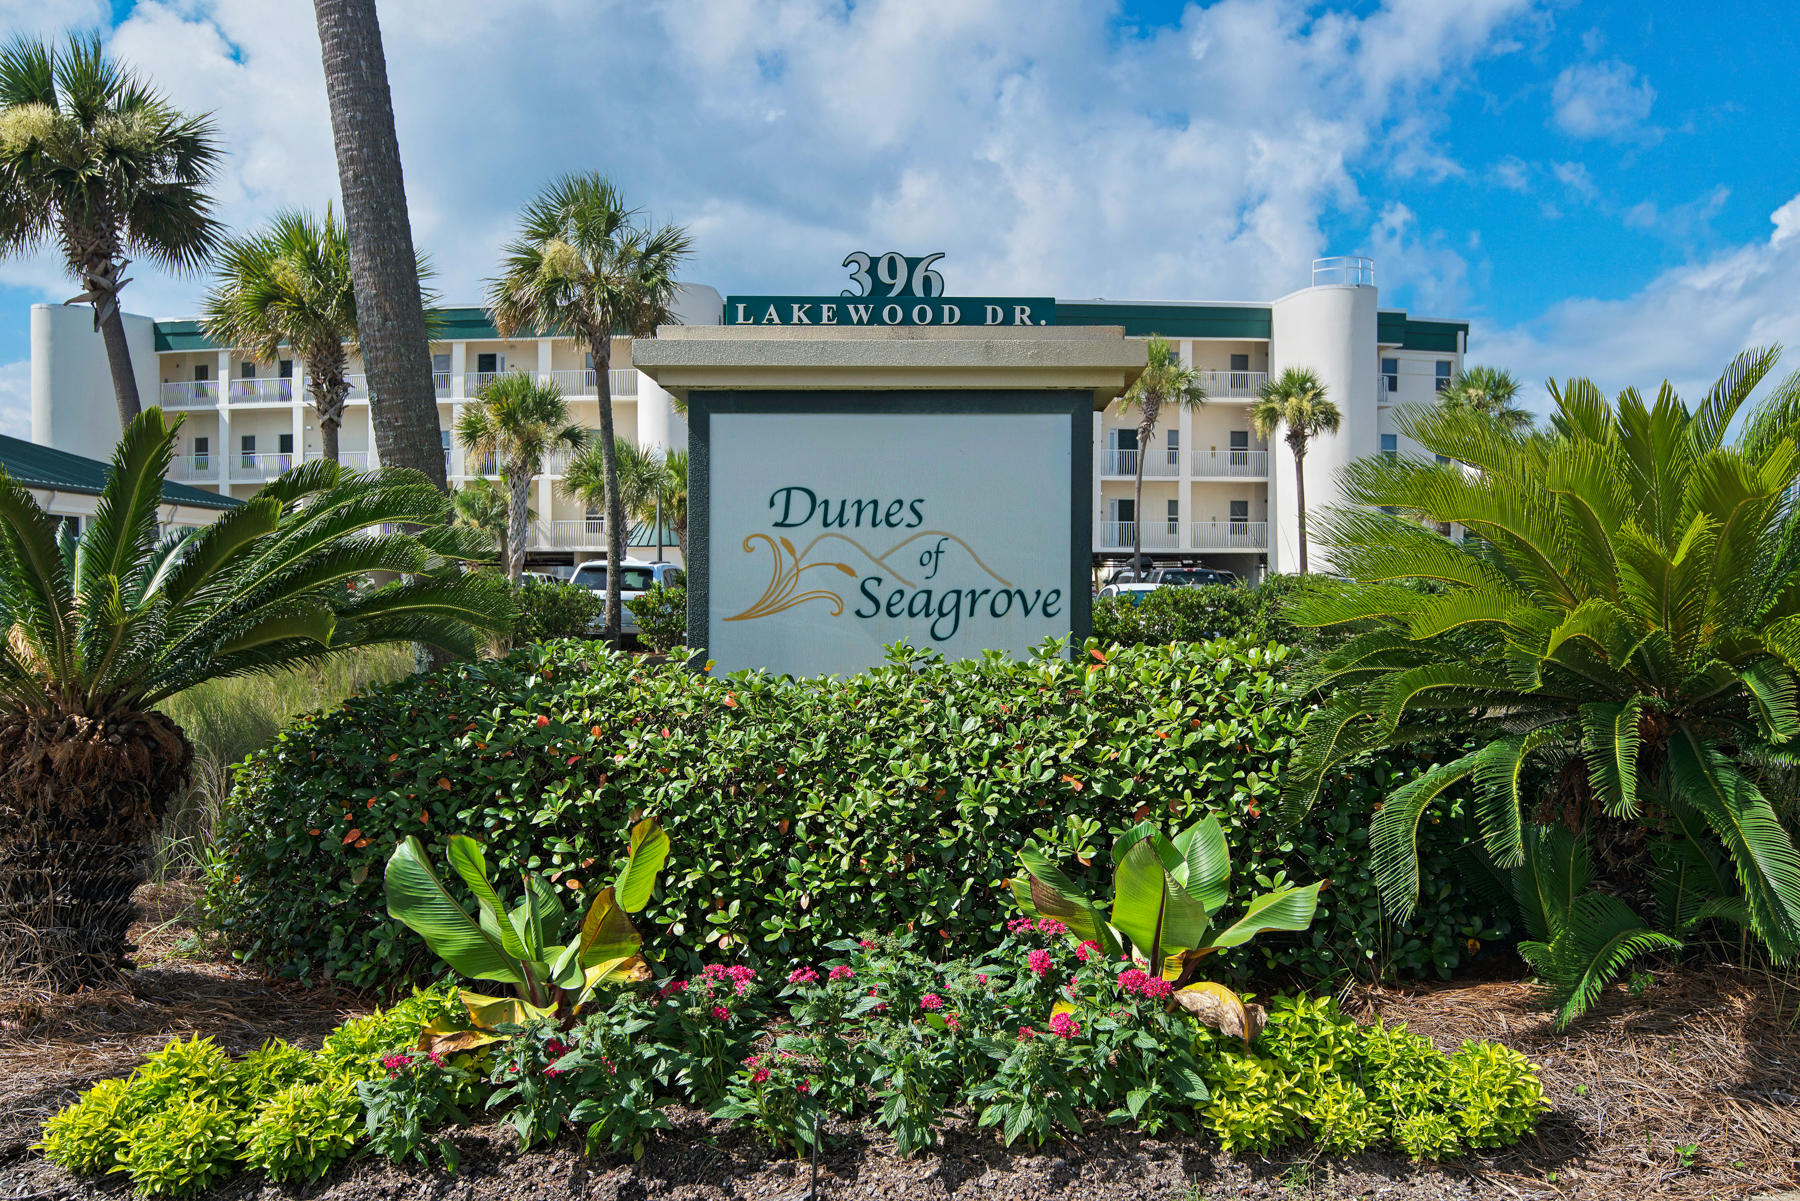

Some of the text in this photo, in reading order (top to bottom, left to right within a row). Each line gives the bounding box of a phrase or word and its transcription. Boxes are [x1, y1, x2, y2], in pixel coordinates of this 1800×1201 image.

[841, 251, 945, 298] 396
[735, 303, 1048, 326] LAKEWOOD DR.
[769, 486, 925, 528] Dunes
[919, 537, 949, 579] of
[854, 577, 1062, 641] Seagrove
